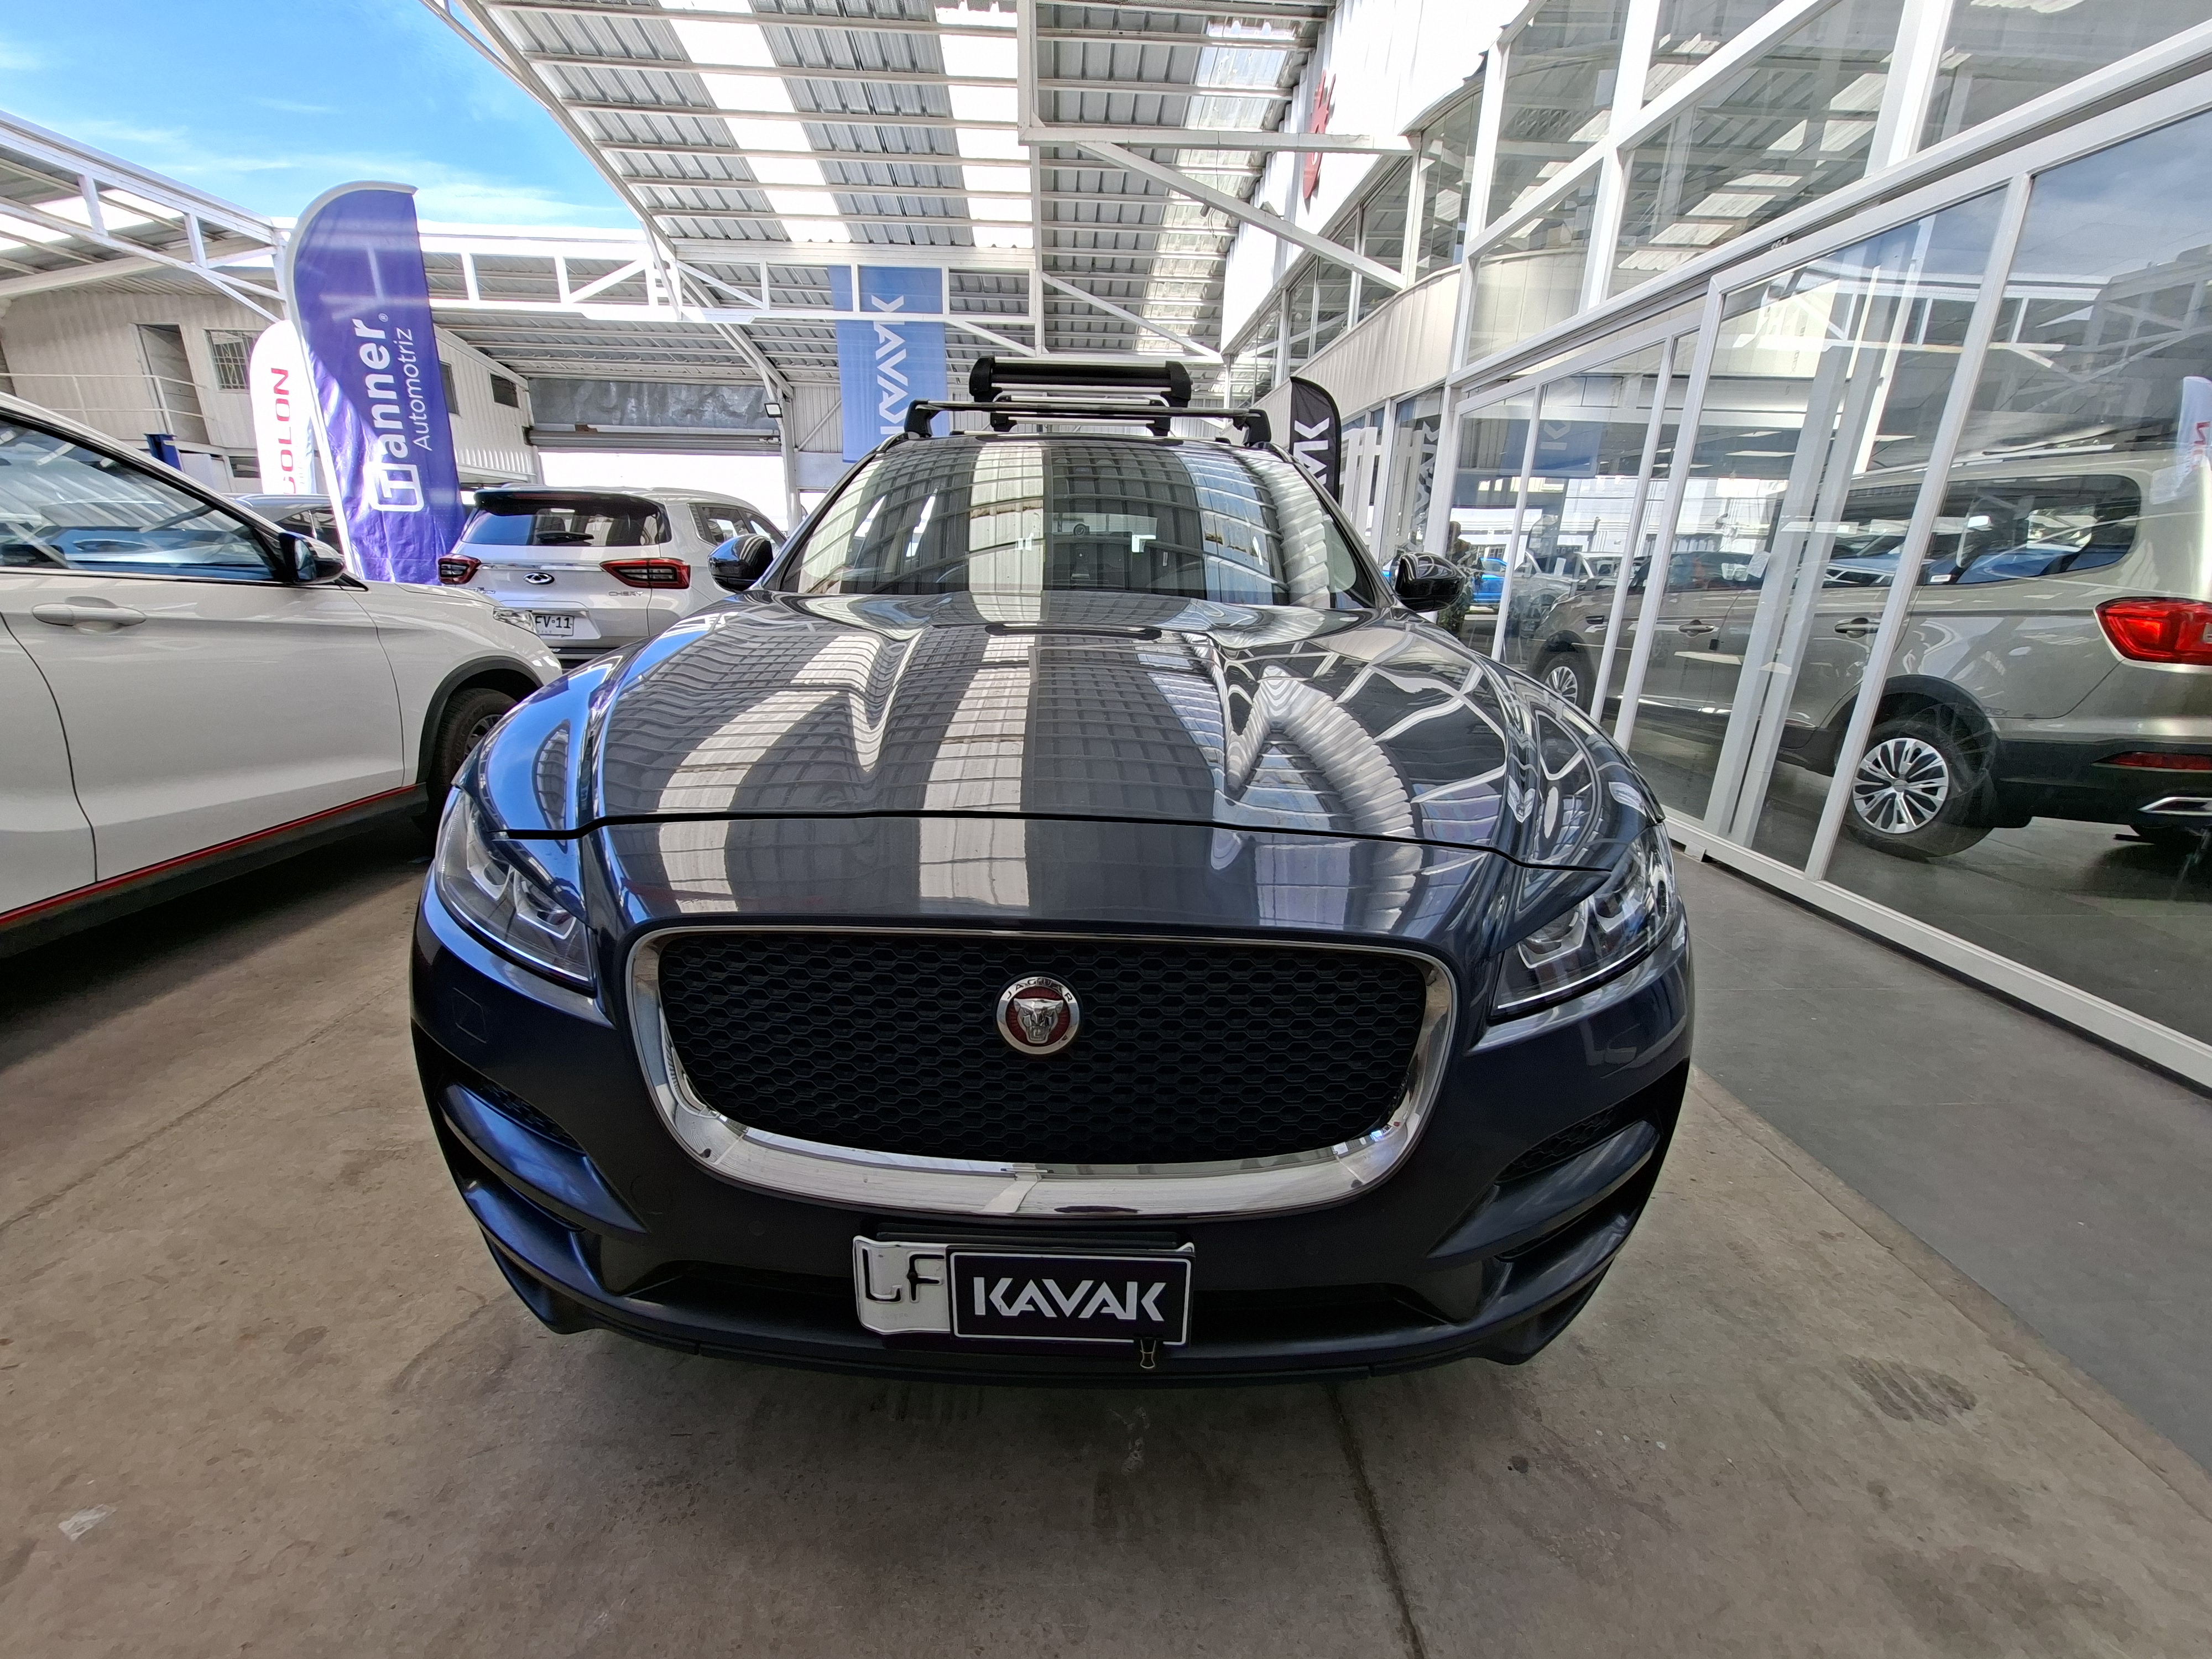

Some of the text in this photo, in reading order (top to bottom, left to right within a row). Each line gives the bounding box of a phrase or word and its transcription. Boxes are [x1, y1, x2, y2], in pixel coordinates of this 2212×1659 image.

[393, 326, 432, 452] Automotriz
[1006, 977, 1073, 1002] JAGUAR
[973, 1276, 1167, 1322] KAVAK
